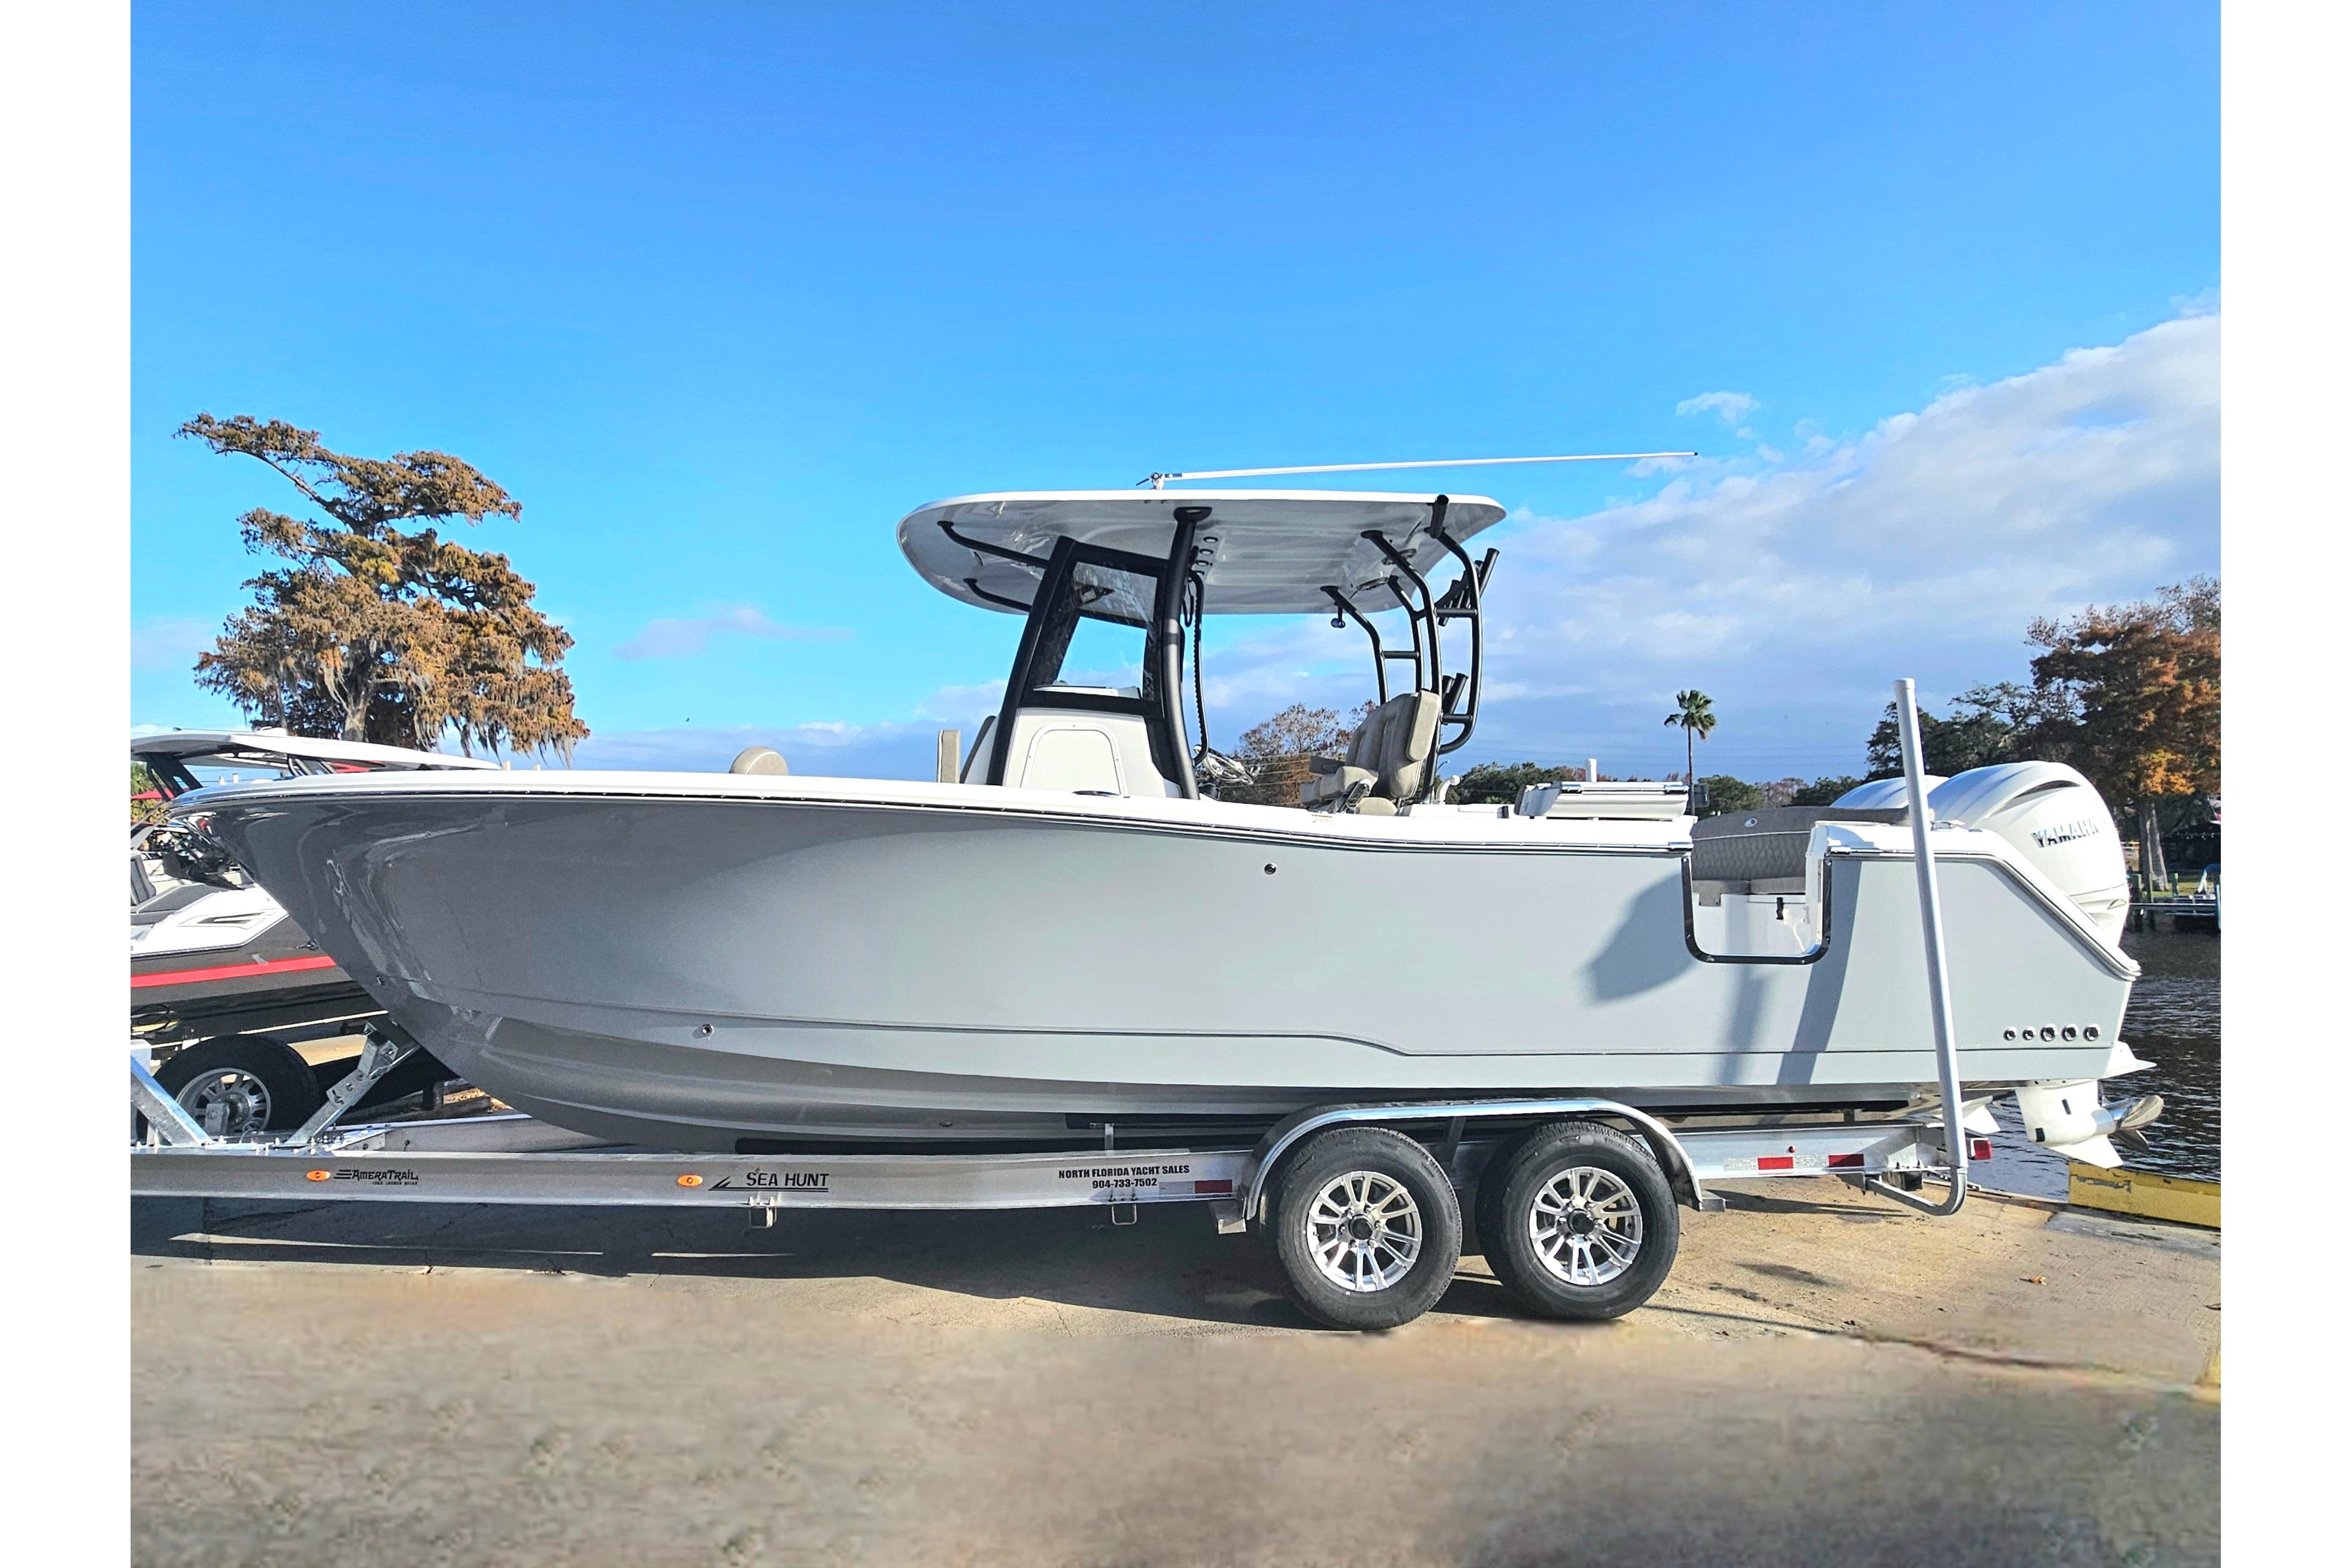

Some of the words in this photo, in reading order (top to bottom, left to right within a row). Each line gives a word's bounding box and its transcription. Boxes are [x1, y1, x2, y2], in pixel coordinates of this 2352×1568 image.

[2030, 819, 2099, 848] YAMAHA
[1058, 1169, 1090, 1179] NORTH
[1092, 1167, 1130, 1177] FLORIDA
[1131, 1166, 1160, 1176] YACHT
[1162, 1165, 1190, 1174] SALES
[746, 1172, 778, 1186] SEA
[784, 1173, 829, 1187] HUNT
[1092, 1177, 1157, 1189] 904-733-7502
